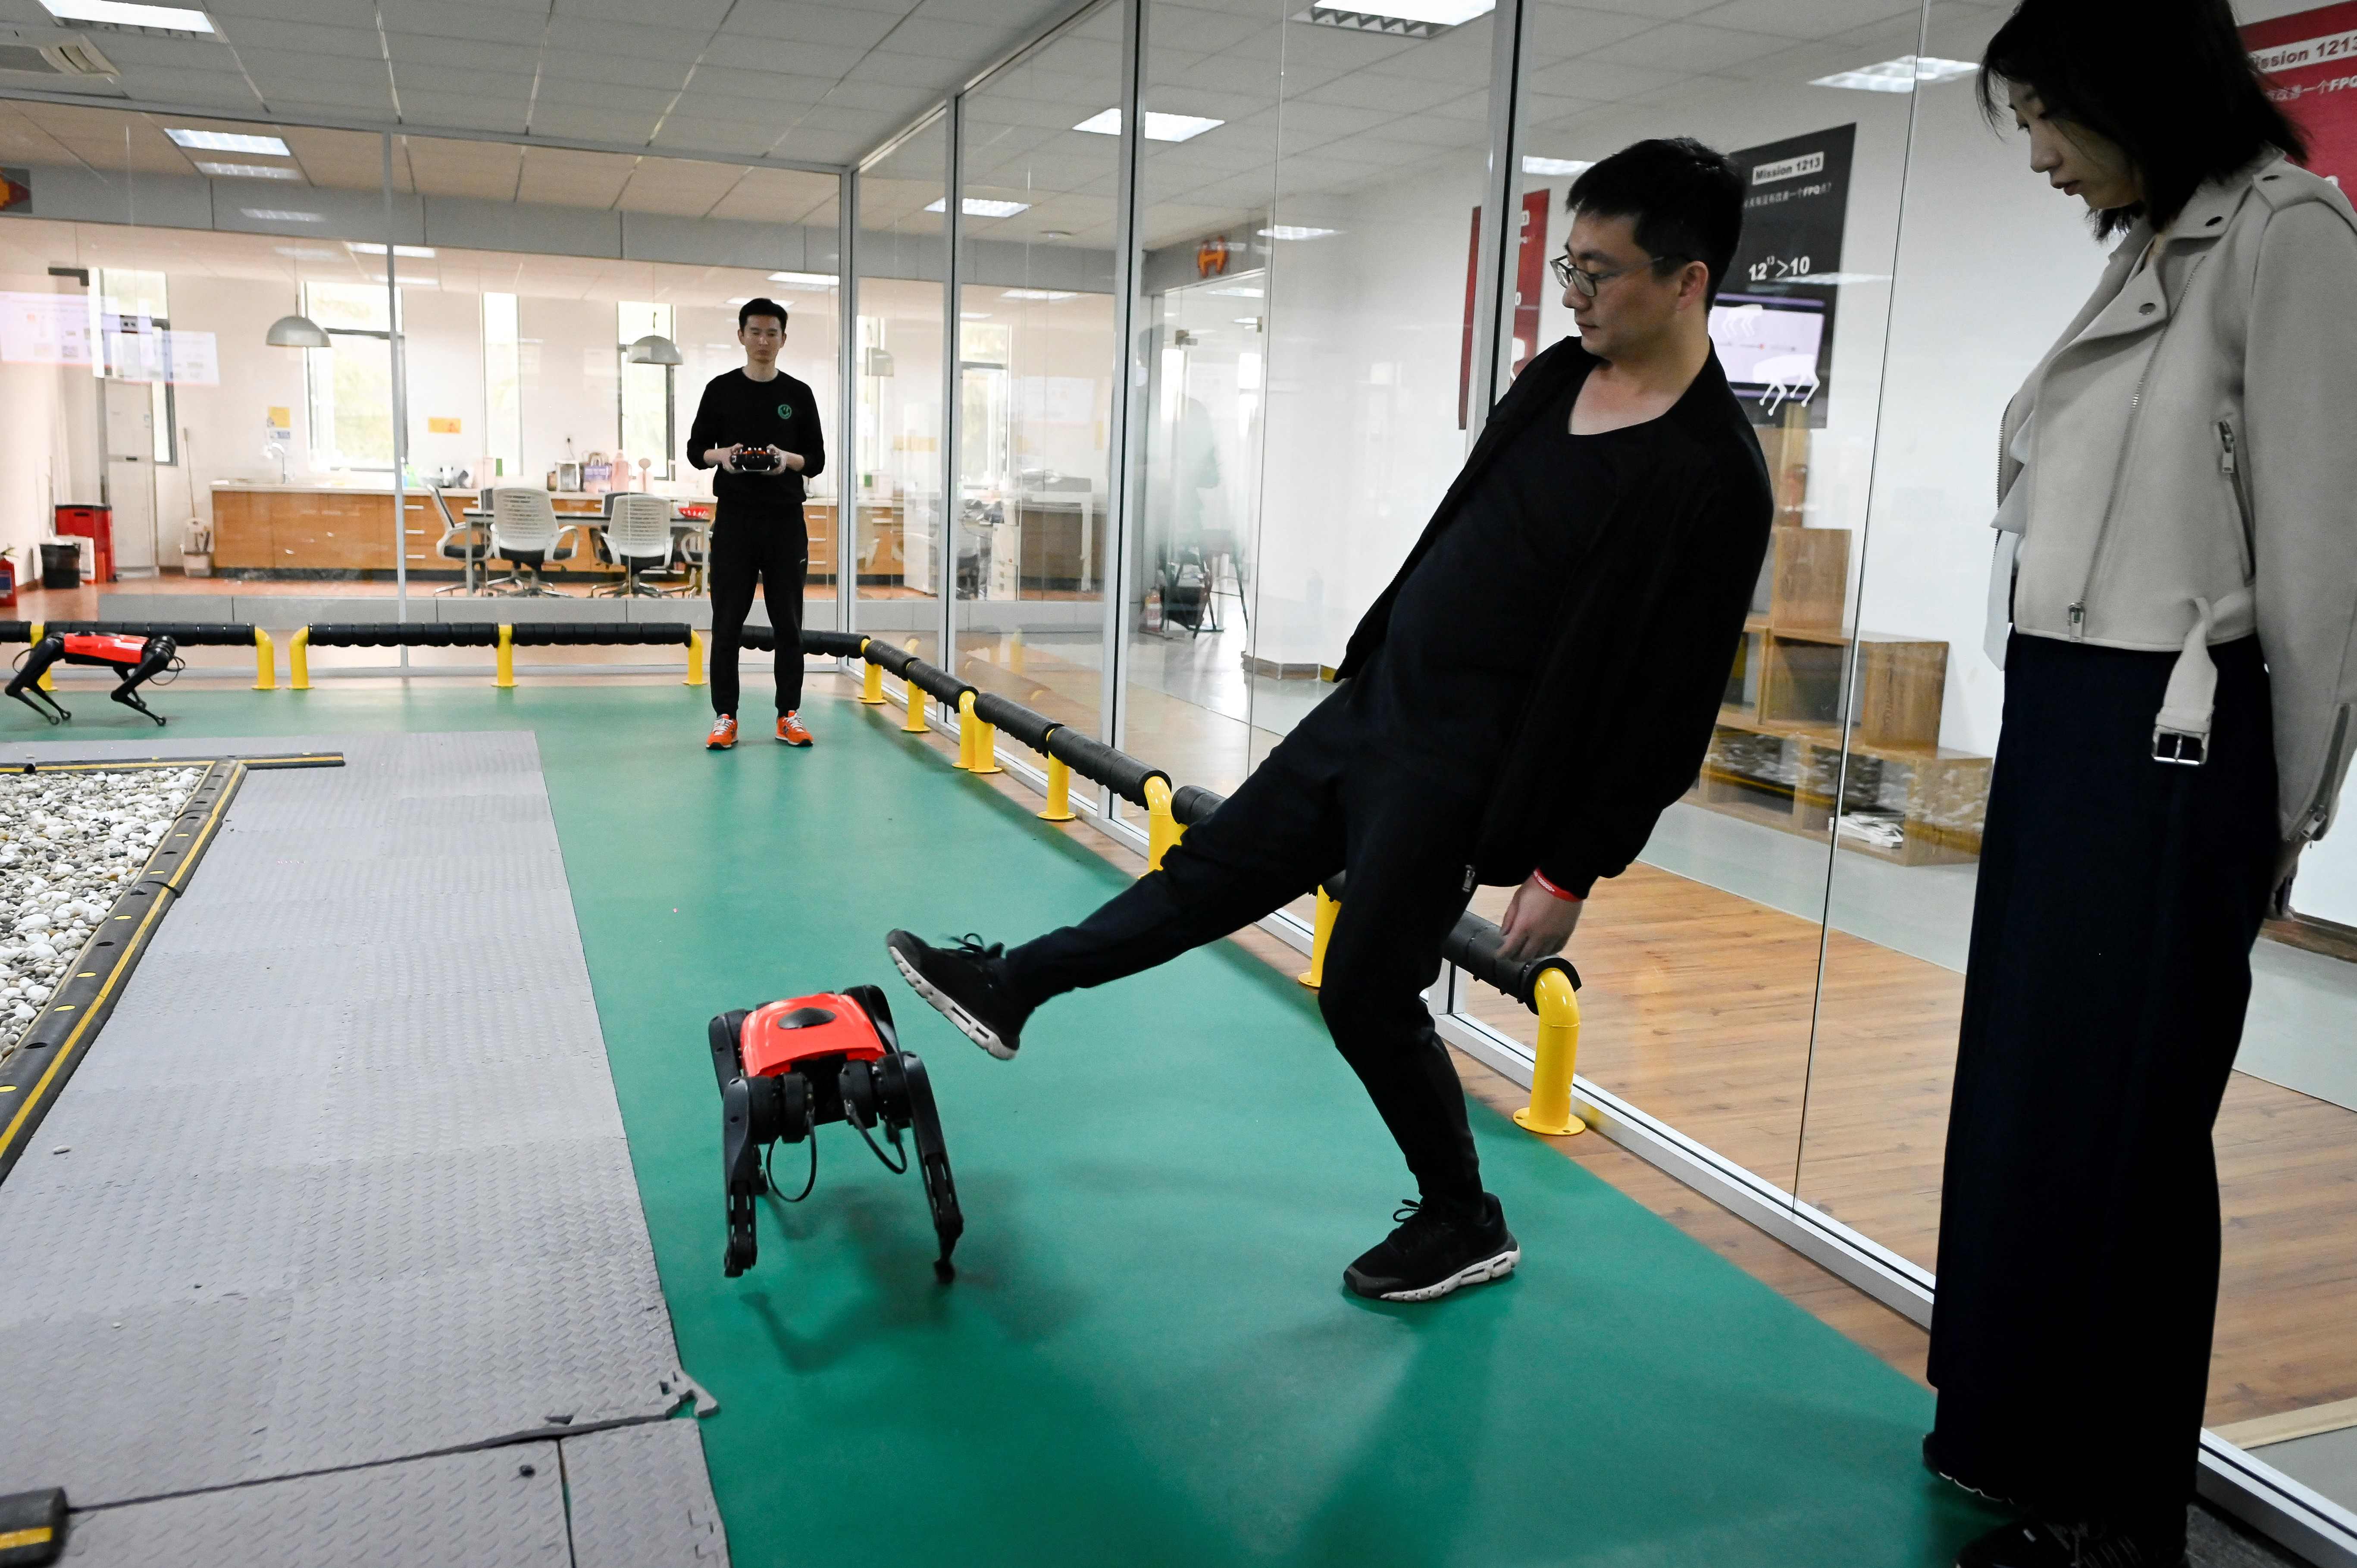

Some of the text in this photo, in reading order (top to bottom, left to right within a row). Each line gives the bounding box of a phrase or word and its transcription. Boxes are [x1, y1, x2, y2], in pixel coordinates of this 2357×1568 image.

[2254, 50, 2309, 69] ission
[1756, 157, 1820, 180] Mission 1213
